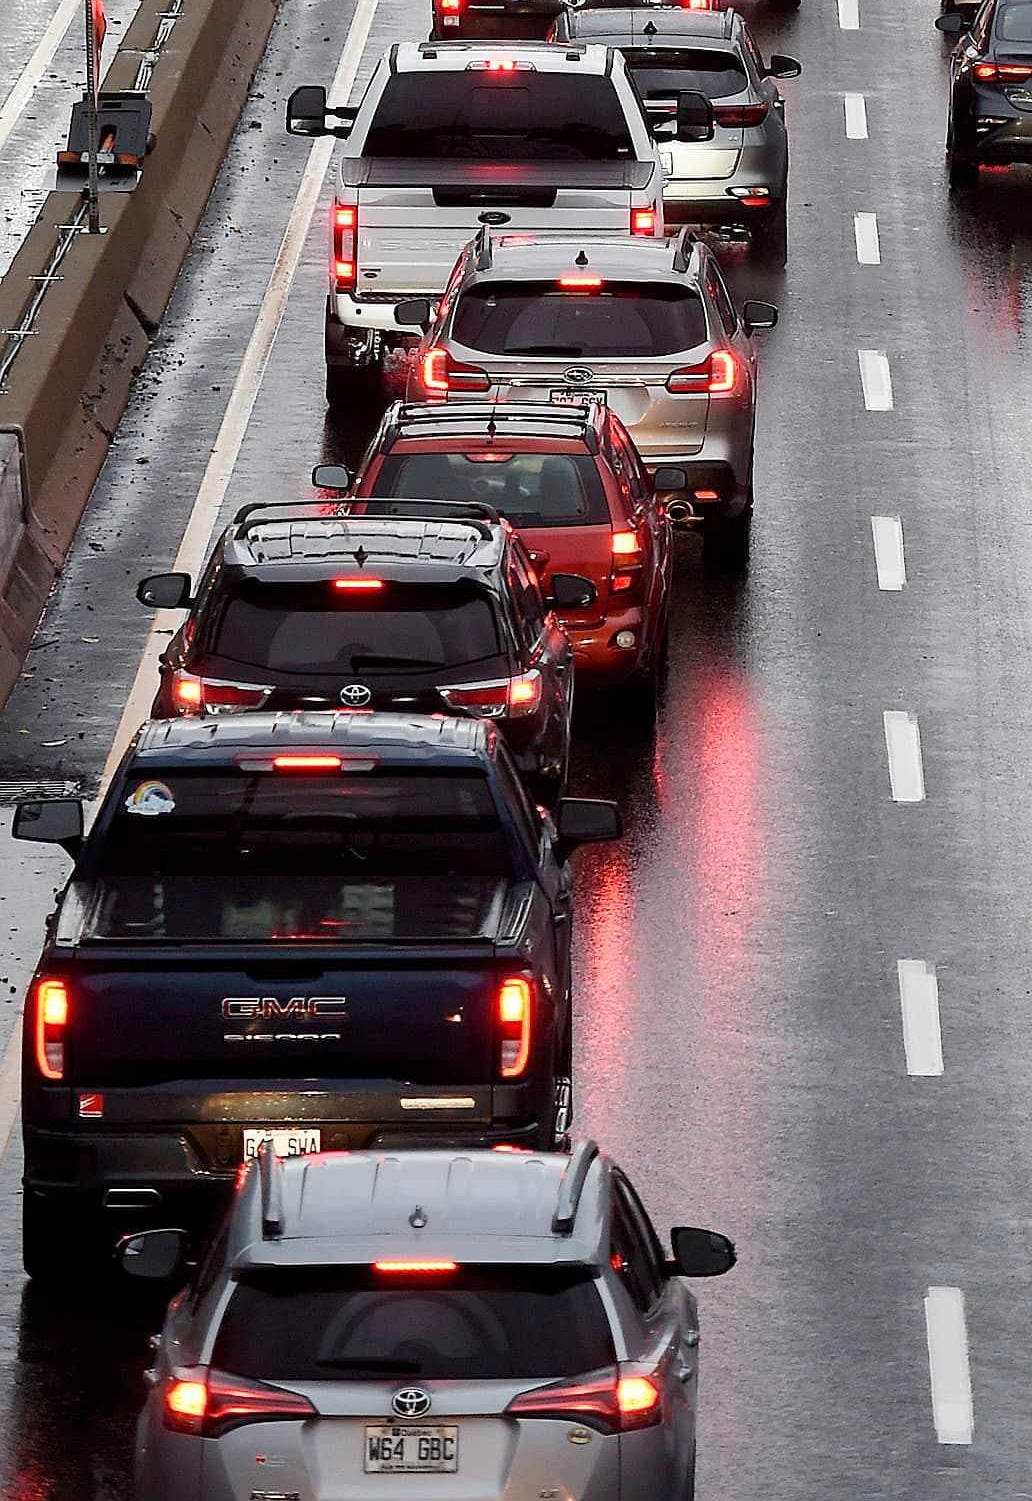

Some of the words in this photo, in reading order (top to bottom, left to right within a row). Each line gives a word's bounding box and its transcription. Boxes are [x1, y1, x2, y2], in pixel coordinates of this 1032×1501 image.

[221, 997, 347, 1020] GMC
[369, 1437, 405, 1461] W64
[418, 1437, 455, 1461] GBC
